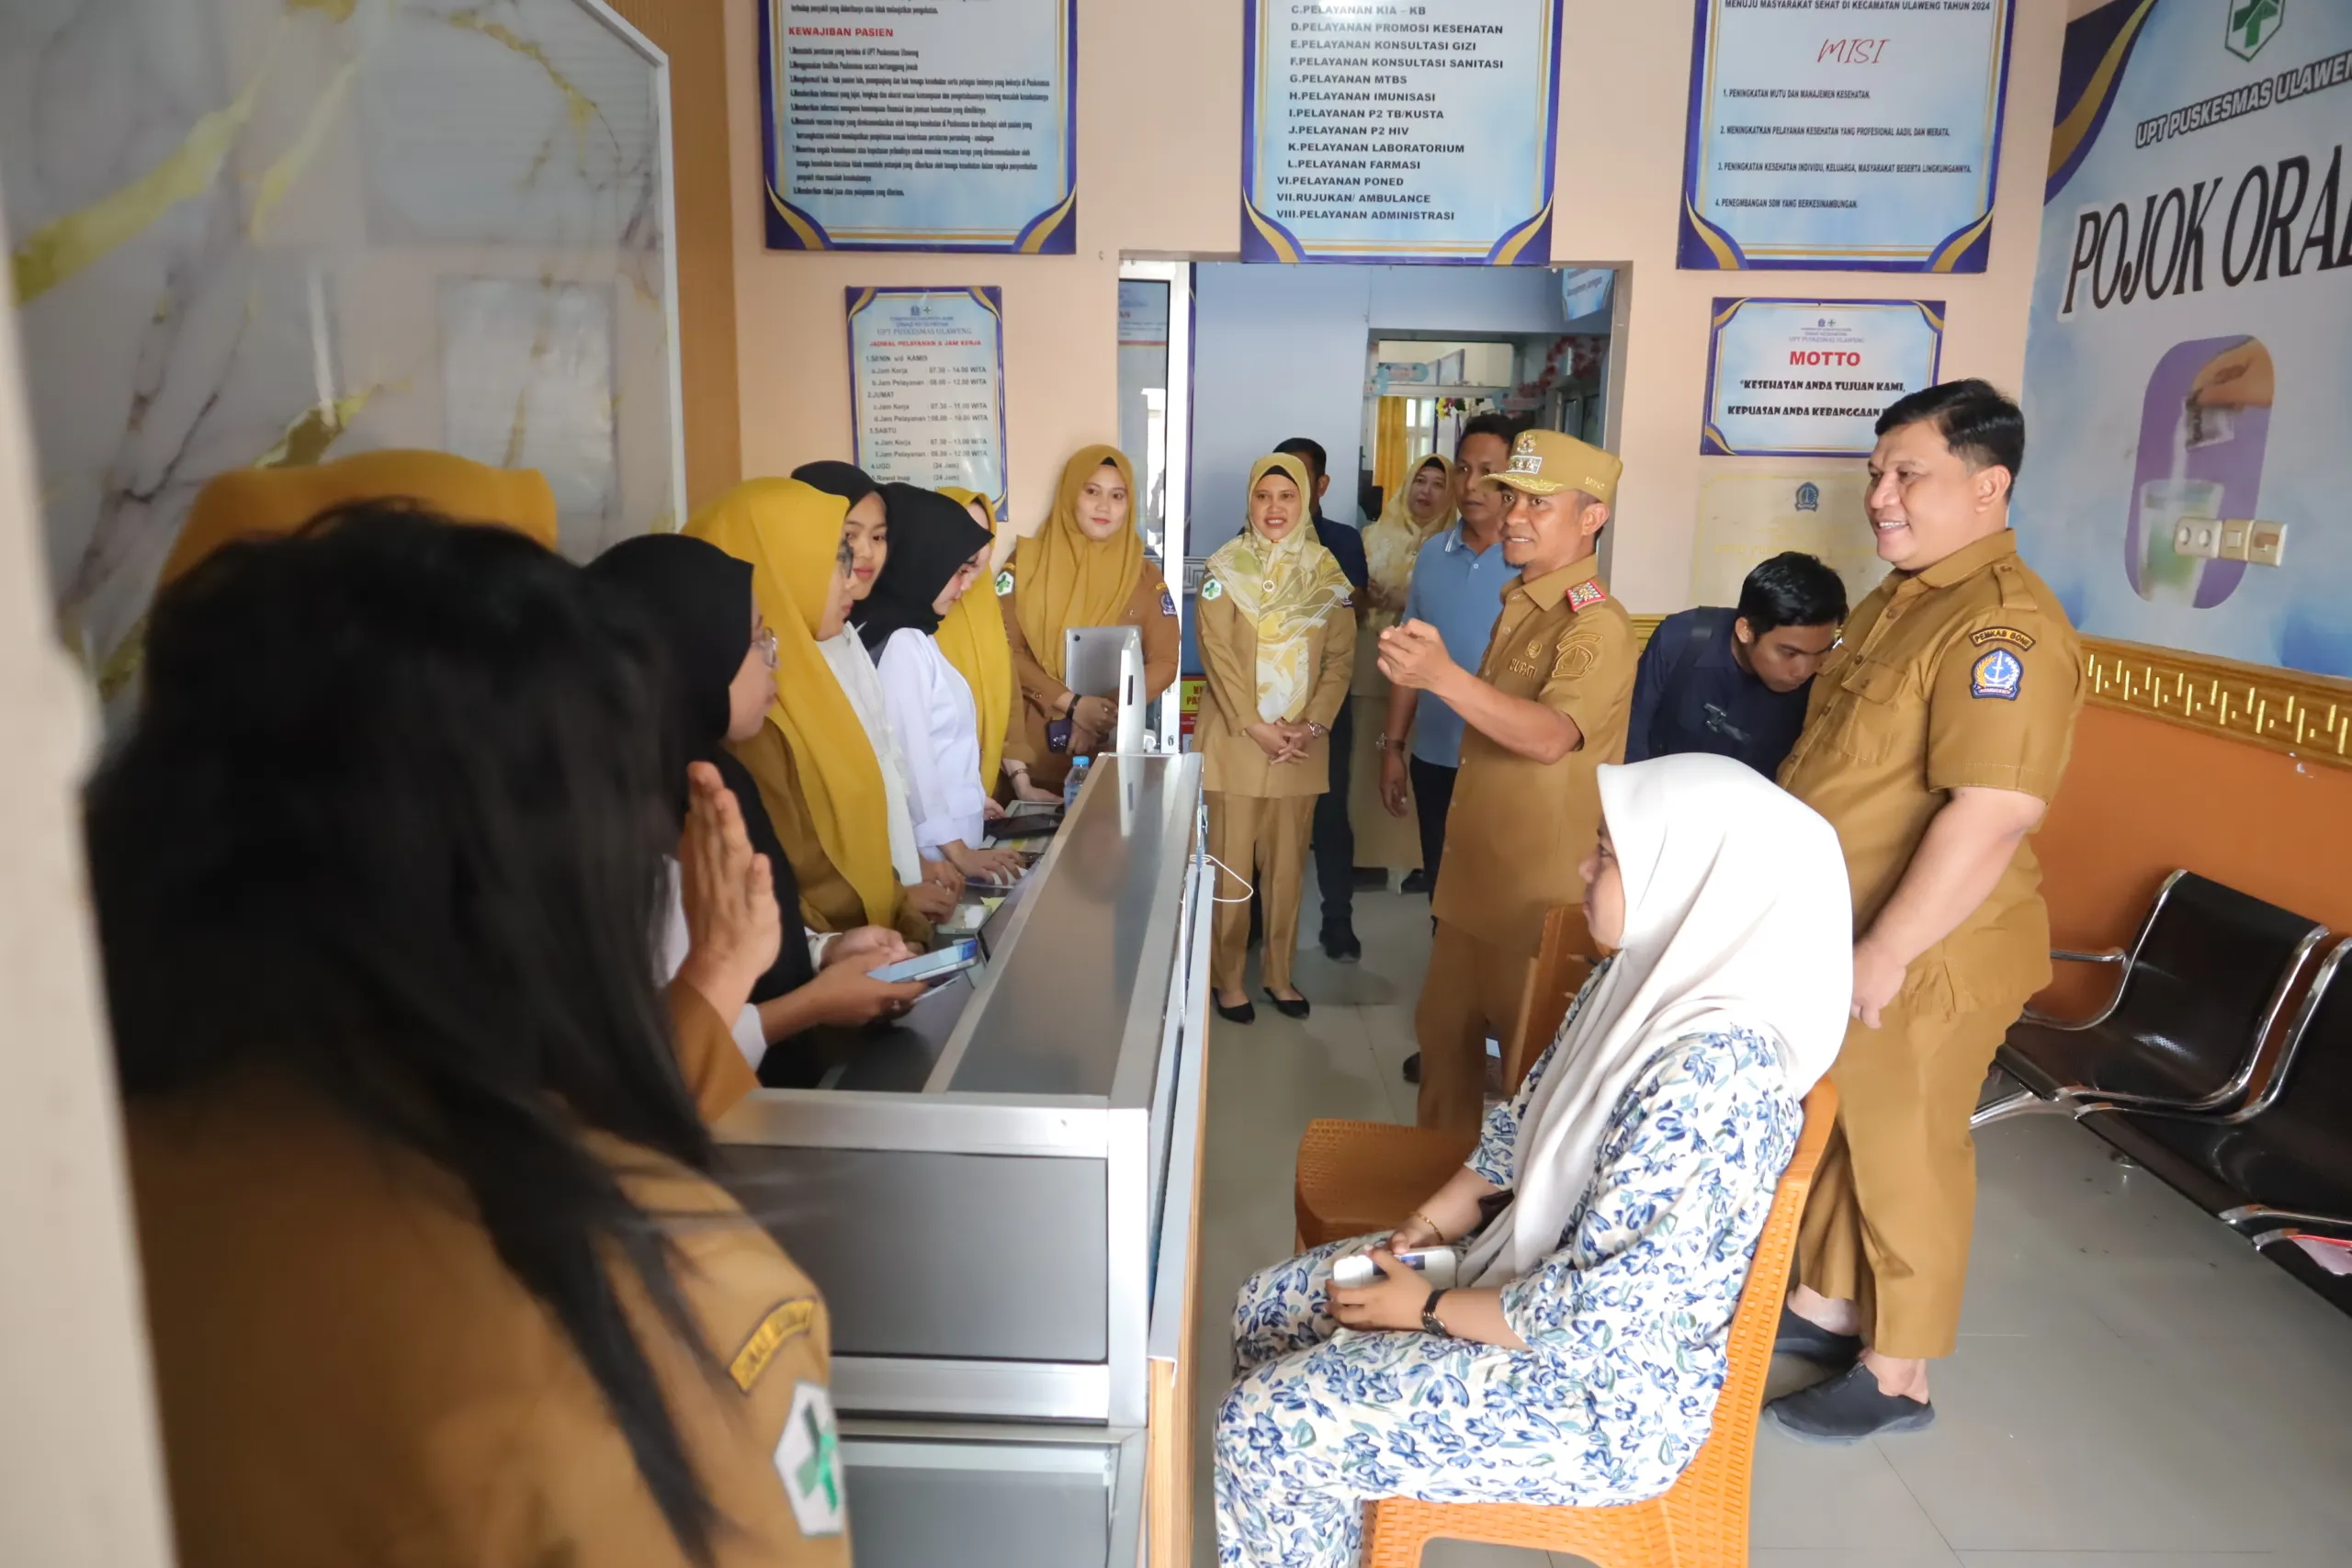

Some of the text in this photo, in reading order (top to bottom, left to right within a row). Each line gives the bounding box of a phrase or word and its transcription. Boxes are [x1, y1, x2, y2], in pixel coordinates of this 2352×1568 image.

[1291, 5, 1372, 15] C.PELAYANAN
[1375, 6, 1396, 16] KIA
[1409, 6, 1425, 16] KB
[1725, 0, 1989, 11] MENUJU MASYARAKAT SEHAT DI KECAMATAN ULAWENG TAHUN 2024
[788, 28, 893, 37] KEWAJIBAN PASIEN
[1291, 23, 1502, 34] D.PELAYANAN PROMOSI KESEHATAN
[1290, 40, 1476, 51] E.PELAYANAN KONSULTASI GIZI
[1817, 39, 1891, 63] MISI
[1290, 58, 1502, 68] F.PELAYANAN KONSULTASI SANITASI
[1290, 75, 1407, 84] G.PELAYANAN MTBS
[1289, 92, 1435, 102] H.PELAYANAN IMUNISASI
[1728, 89, 1769, 99] PENINGKATAN
[1770, 89, 1786, 99] MUTU
[1787, 89, 1799, 99] DAN
[1800, 89, 1835, 99] MANAJEMEN
[1289, 108, 1443, 118] I.PELAYANAN P2 TB/KUSTA
[2136, 114, 2170, 149] UPT
[2167, 77, 2274, 140] PUSKESMAS
[1288, 126, 1408, 135] J.PELAYANAN P2 HIV
[1720, 126, 1724, 135] 2.
[1726, 126, 1770, 136] MENINGKATKAN
[1771, 126, 1804, 136] PELAYANAN
[1805, 126, 1838, 136] KESEHATAN
[1840, 127, 1855, 136] YANG
[1856, 127, 1894, 137] PROFESIONAL
[1914, 127, 1925, 137] DAN
[1288, 143, 1464, 152] K.PELAYANAN LABORATORIUM
[1287, 160, 1419, 169] L.PELAYANAN FARMASI
[1718, 163, 1723, 172] 3.
[1724, 163, 1763, 173] PENINGKATAN
[1764, 163, 1797, 173] KESEHATAN
[1858, 164, 1894, 174] MASYARAKAT
[1896, 164, 1920, 174] BESERTA
[1277, 176, 1403, 186] VI.PELAYANAN PONED
[1276, 194, 1430, 203] VII.RUJUKAN/ AMBULANCE
[1714, 198, 1720, 208] 4.
[1781, 199, 1796, 209] YANG
[1276, 209, 1453, 220] VIII.PELAYANAN ADMINISTRASI
[2062, 176, 2223, 314] POJOK
[1790, 351, 1861, 367] MOTTO
[1804, 380, 1832, 390] ANDA
[1835, 380, 1874, 391] TUJUAN
[1876, 380, 1905, 391] KAMI,
[1727, 406, 1781, 416] KEPUASAN
[1782, 407, 1809, 416] ANDA
[1812, 407, 1879, 417] KEBANGGAAN
[1974, 630, 2030, 648] PEMKAB BONE
